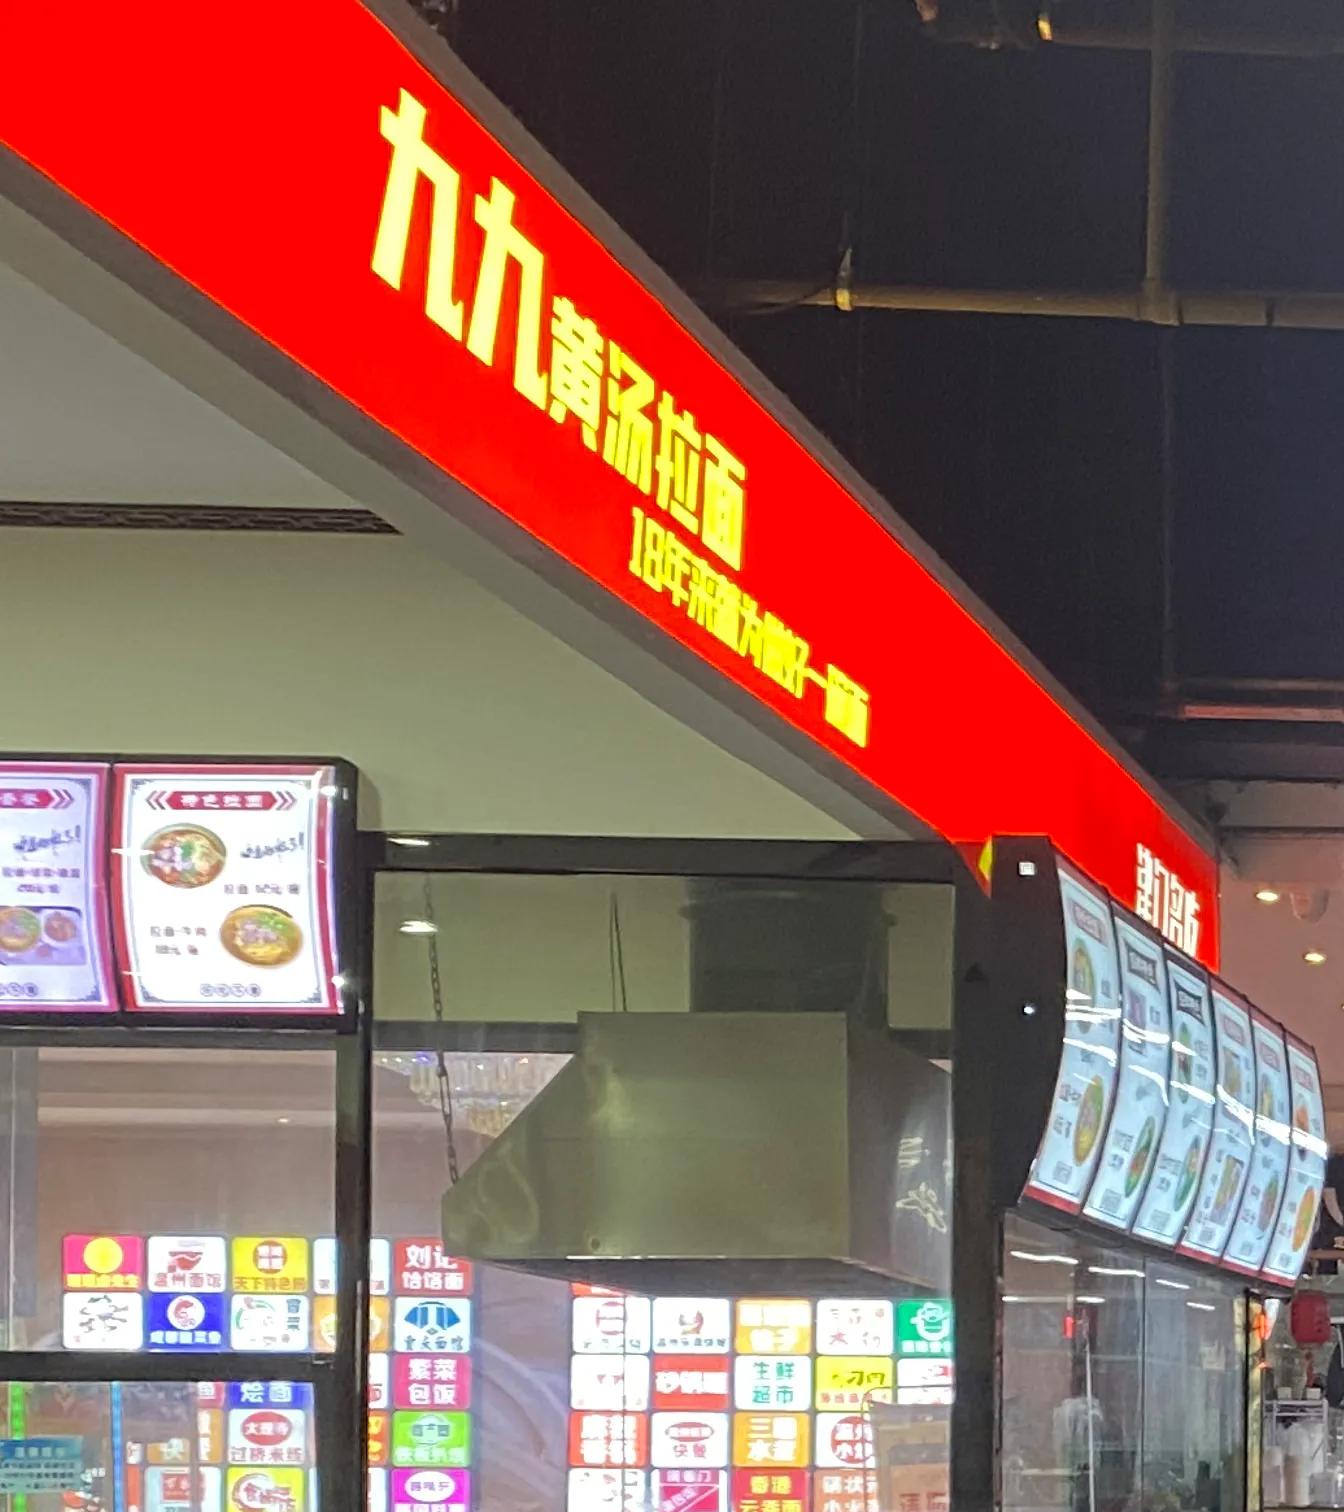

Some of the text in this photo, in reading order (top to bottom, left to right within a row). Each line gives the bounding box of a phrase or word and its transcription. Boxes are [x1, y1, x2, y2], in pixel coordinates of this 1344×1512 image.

[370, 88, 747, 571] 九九黄汤拉面
[752, 1361, 796, 1381] 生鲜
[751, 1385, 795, 1404] 超市
